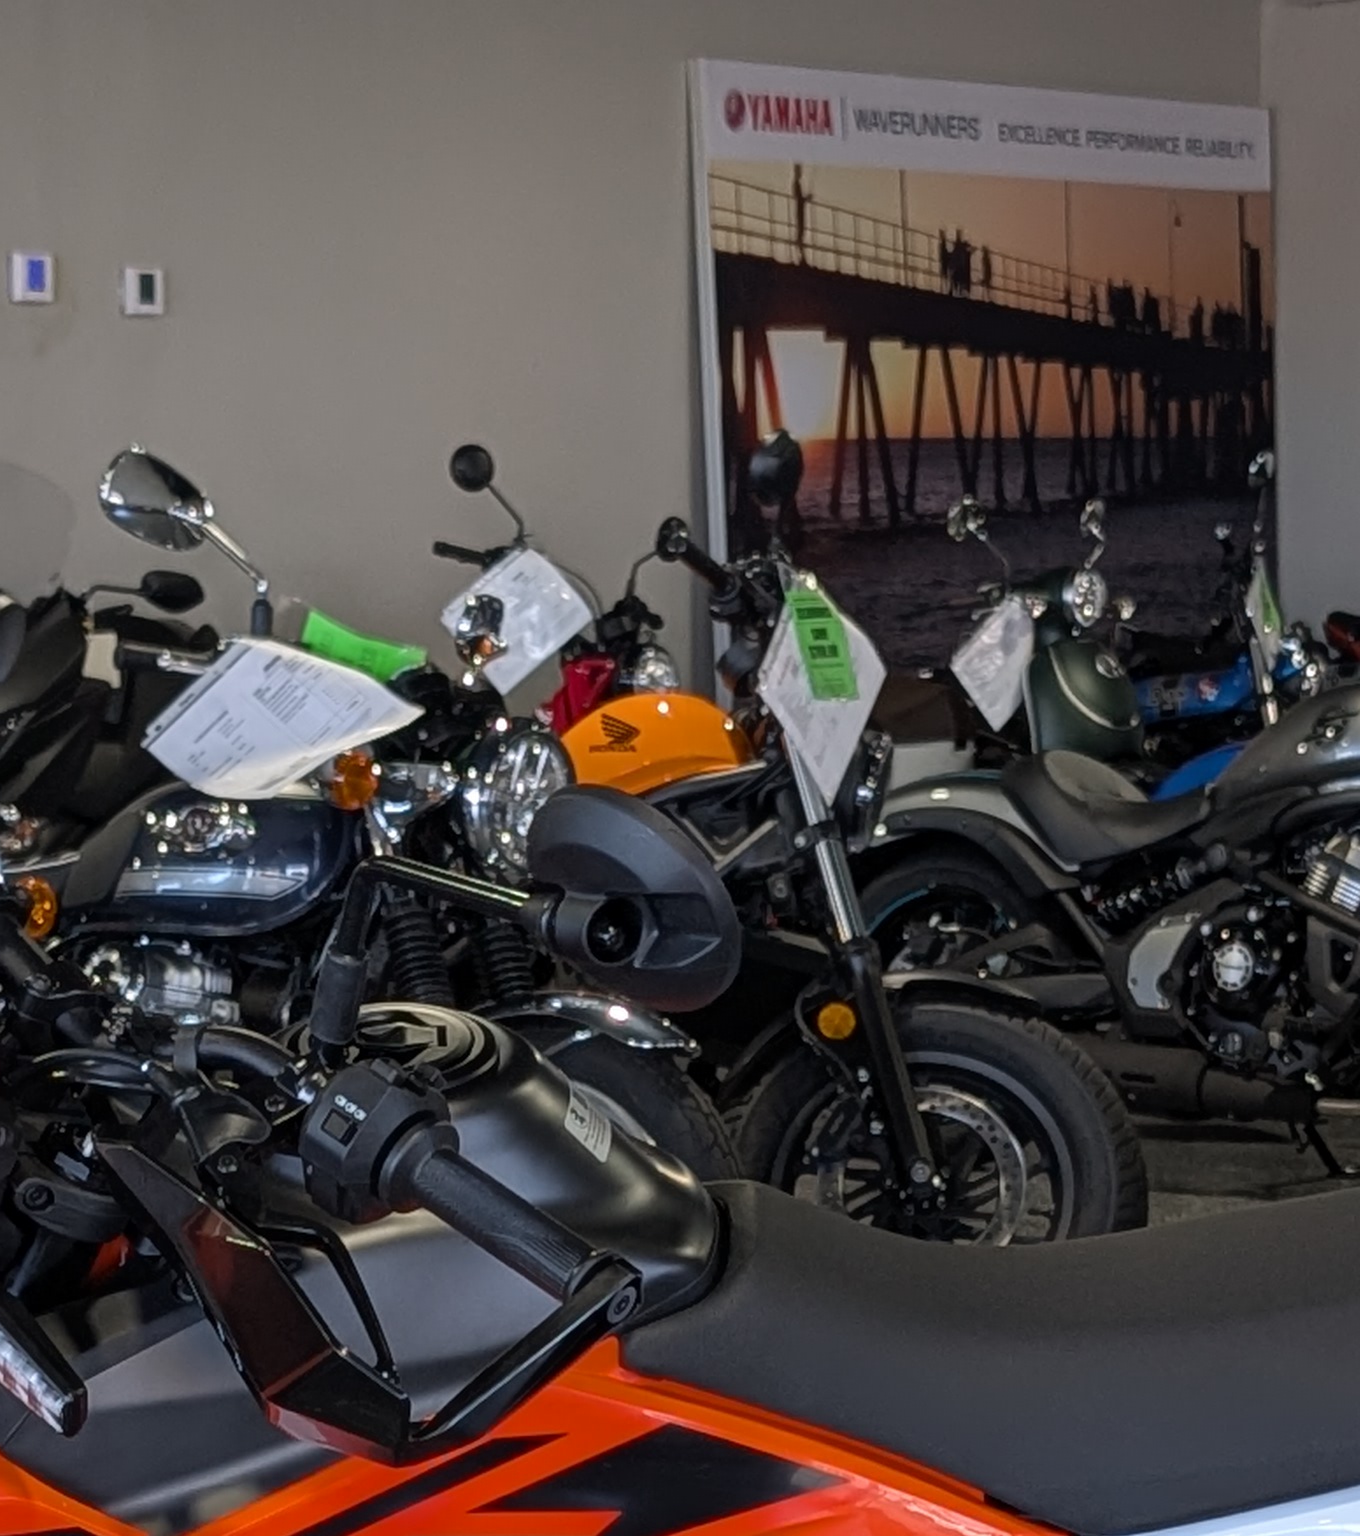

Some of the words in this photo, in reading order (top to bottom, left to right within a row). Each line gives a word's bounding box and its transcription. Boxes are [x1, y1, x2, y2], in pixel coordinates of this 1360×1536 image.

[747, 93, 834, 136] YAMAHA
[853, 107, 982, 141] WAVERUNNERS
[997, 123, 1081, 147] EXCELLENCE
[1085, 130, 1181, 155] PERFORMANCE
